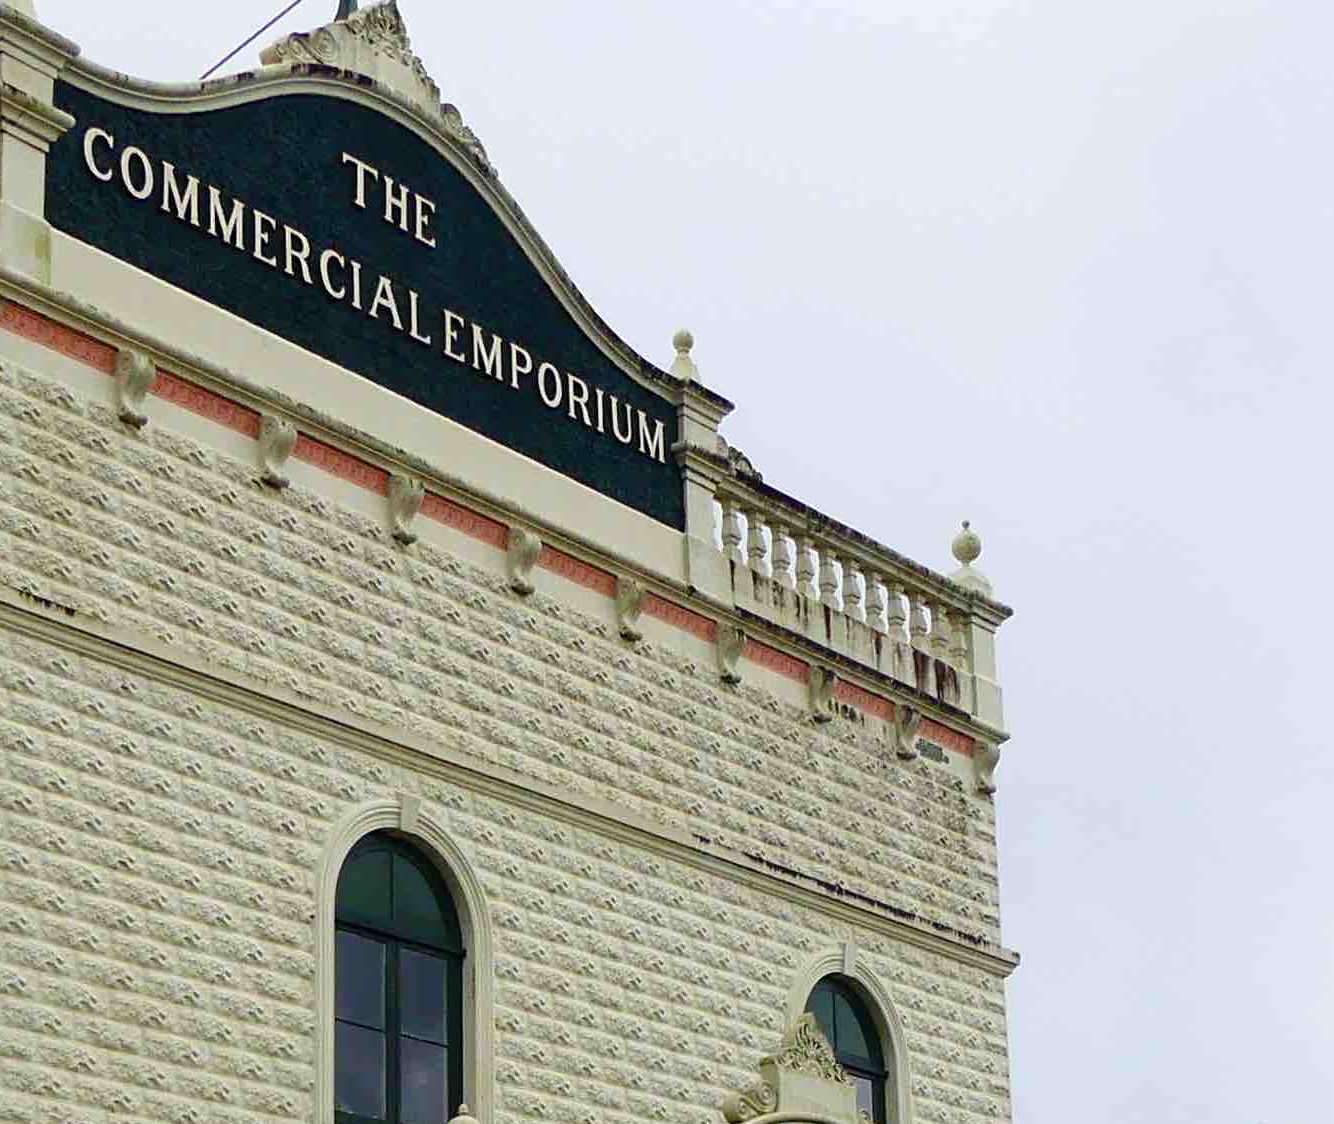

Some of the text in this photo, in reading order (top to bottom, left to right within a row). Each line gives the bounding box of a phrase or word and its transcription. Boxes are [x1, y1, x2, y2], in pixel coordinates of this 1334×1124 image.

[83, 126, 668, 464] COMMERCIAL EMPORIUM
[342, 152, 436, 248] THE
